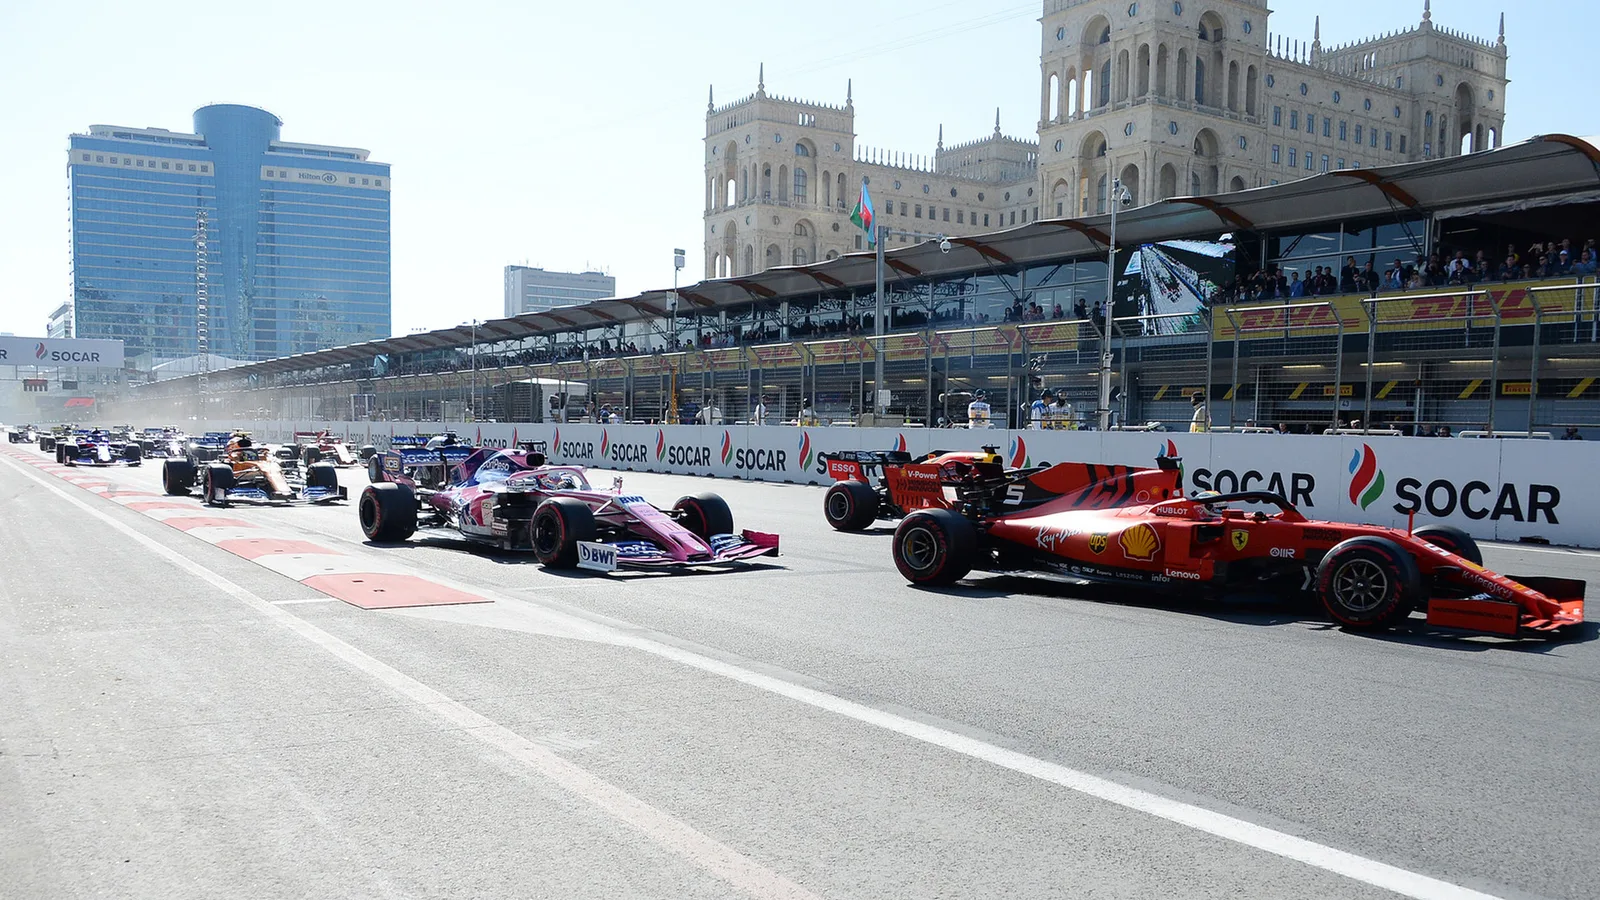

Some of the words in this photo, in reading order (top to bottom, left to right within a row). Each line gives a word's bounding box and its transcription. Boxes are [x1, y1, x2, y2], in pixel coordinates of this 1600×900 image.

[298, 172, 321, 181] Hilton
[51, 350, 100, 362] SOCAR
[562, 441, 594, 459] SOCAR
[611, 443, 648, 463] SOCAR
[668, 445, 711, 467] SOCAR
[735, 449, 786, 472] SOCAR
[831, 463, 856, 473] ESSO
[1002, 484, 1025, 506] 5
[1191, 468, 1315, 507] SOCAR
[1393, 477, 1561, 524] SOCAR
[1156, 506, 1188, 515] HUBLOT
[1090, 534, 1107, 551] ups
[592, 547, 615, 566] BWT
[1166, 568, 1201, 580] Lenovo
